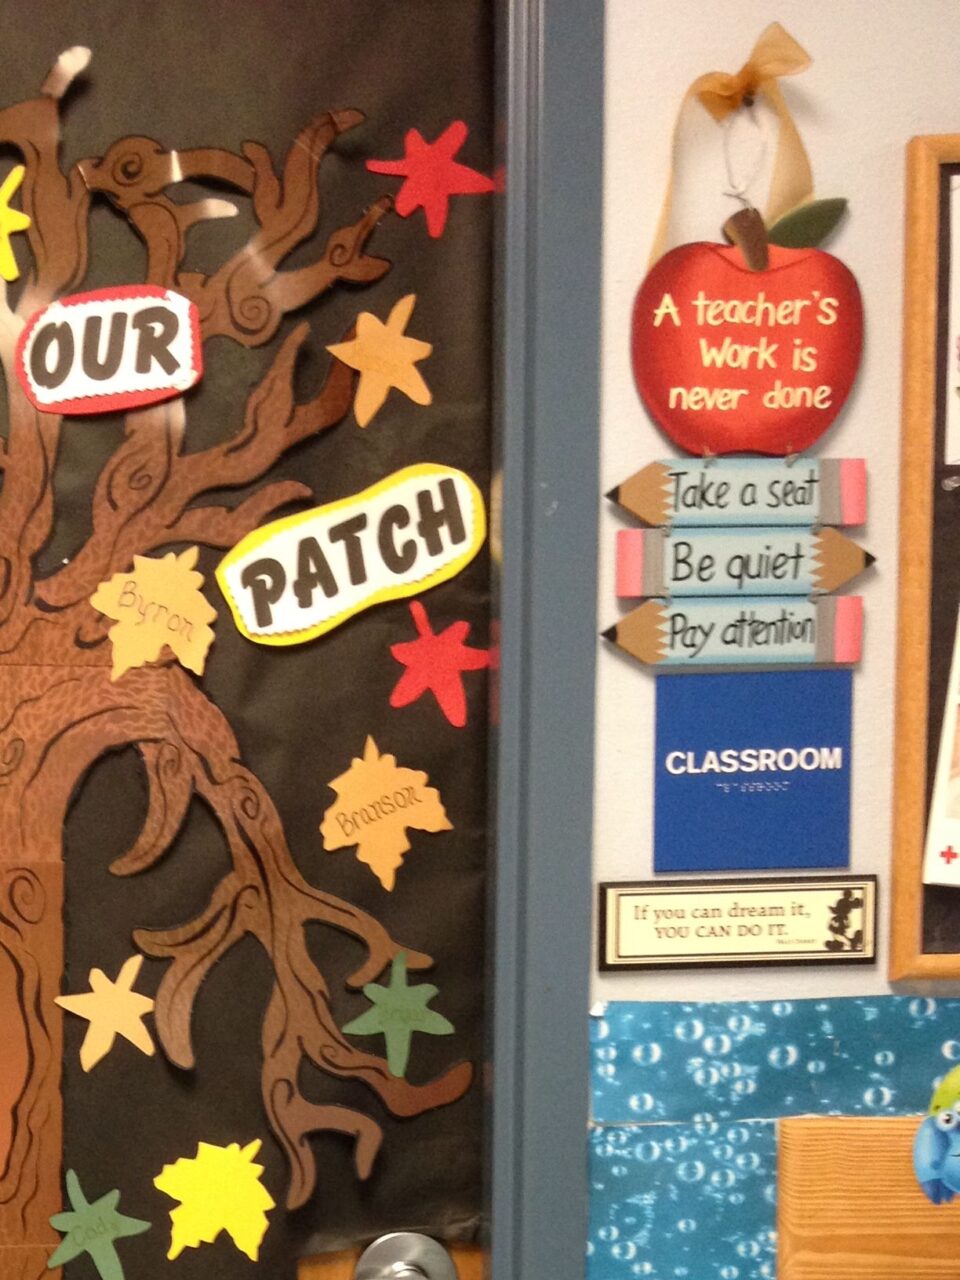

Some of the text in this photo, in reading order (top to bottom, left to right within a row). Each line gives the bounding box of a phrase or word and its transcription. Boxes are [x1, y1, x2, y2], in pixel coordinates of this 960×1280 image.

[653, 291, 839, 327] A teacher's
[30, 306, 181, 390] OUR
[700, 337, 817, 372] Work is
[669, 380, 832, 411] never done
[668, 470, 819, 510] Take a seat
[241, 478, 467, 628] PATCH
[672, 542, 803, 590] Be quiet
[119, 580, 192, 642] Byron
[669, 613, 816, 659] Pay attention
[665, 748, 843, 775] CLASSROOM
[336, 786, 423, 837] Branson
[634, 901, 811, 924] If you can dream it,
[655, 923, 789, 939] YOU CAN DO IT.
